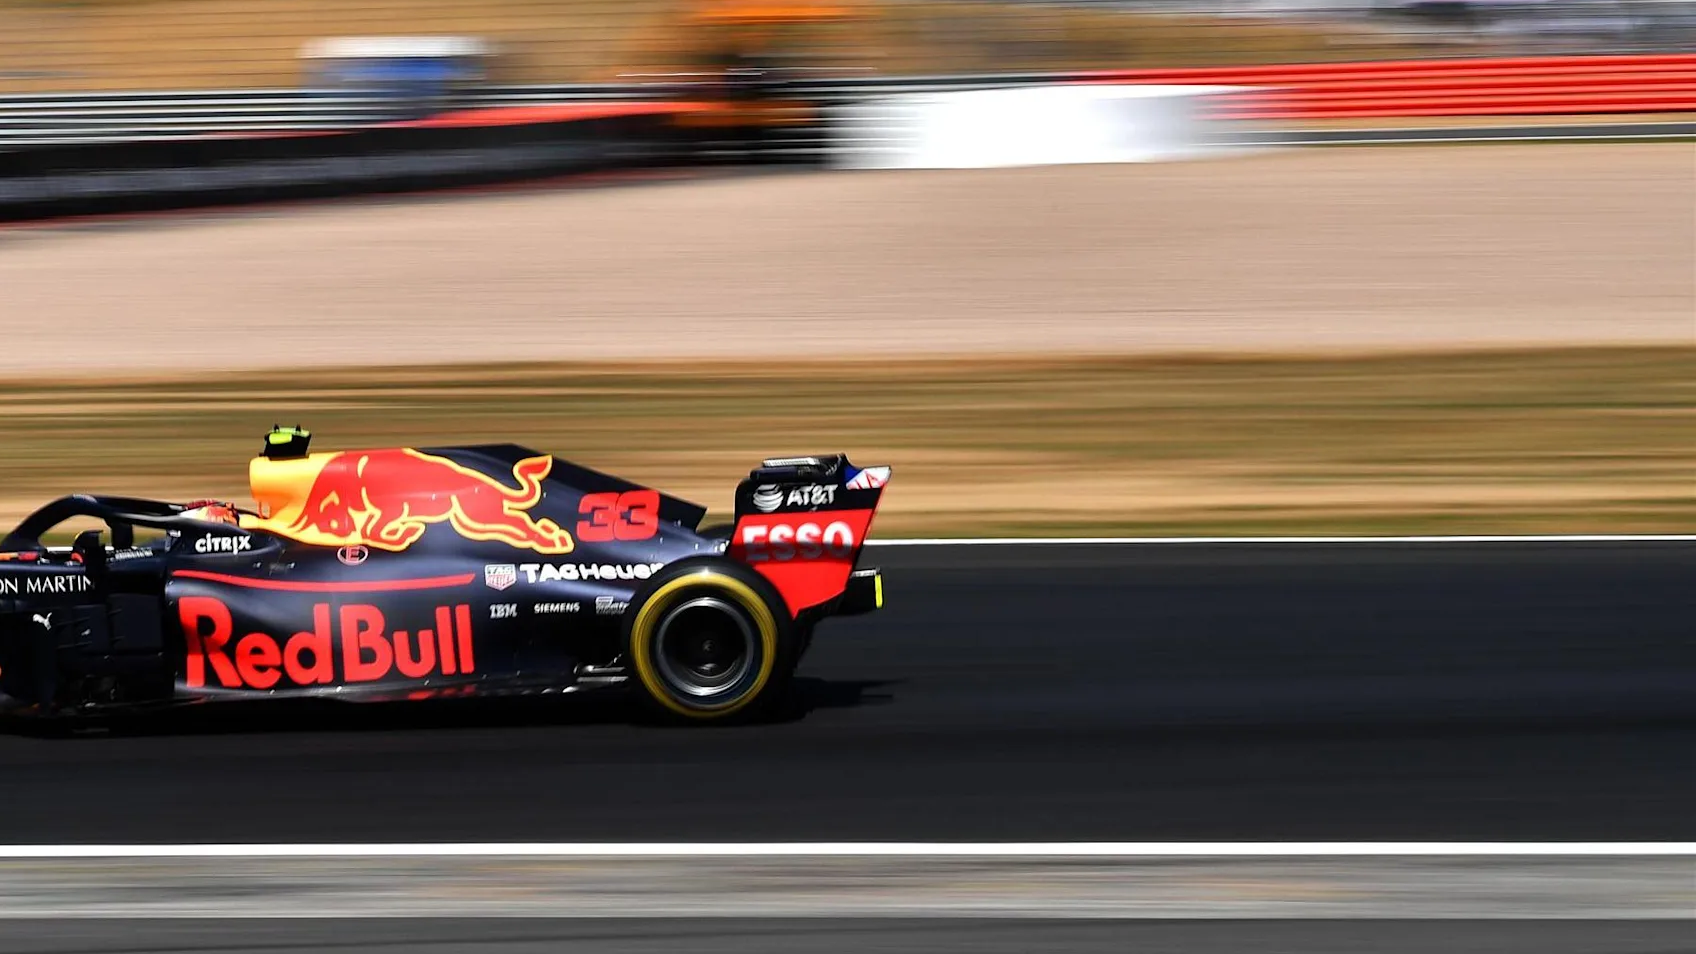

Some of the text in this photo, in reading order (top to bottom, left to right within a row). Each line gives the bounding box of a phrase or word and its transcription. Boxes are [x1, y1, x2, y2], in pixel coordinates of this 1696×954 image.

[786, 484, 838, 507] AT&T
[576, 490, 660, 542] 33
[742, 521, 854, 561] ESSO
[489, 603, 518, 619] IBM
[534, 602, 580, 614] SIEMENS
